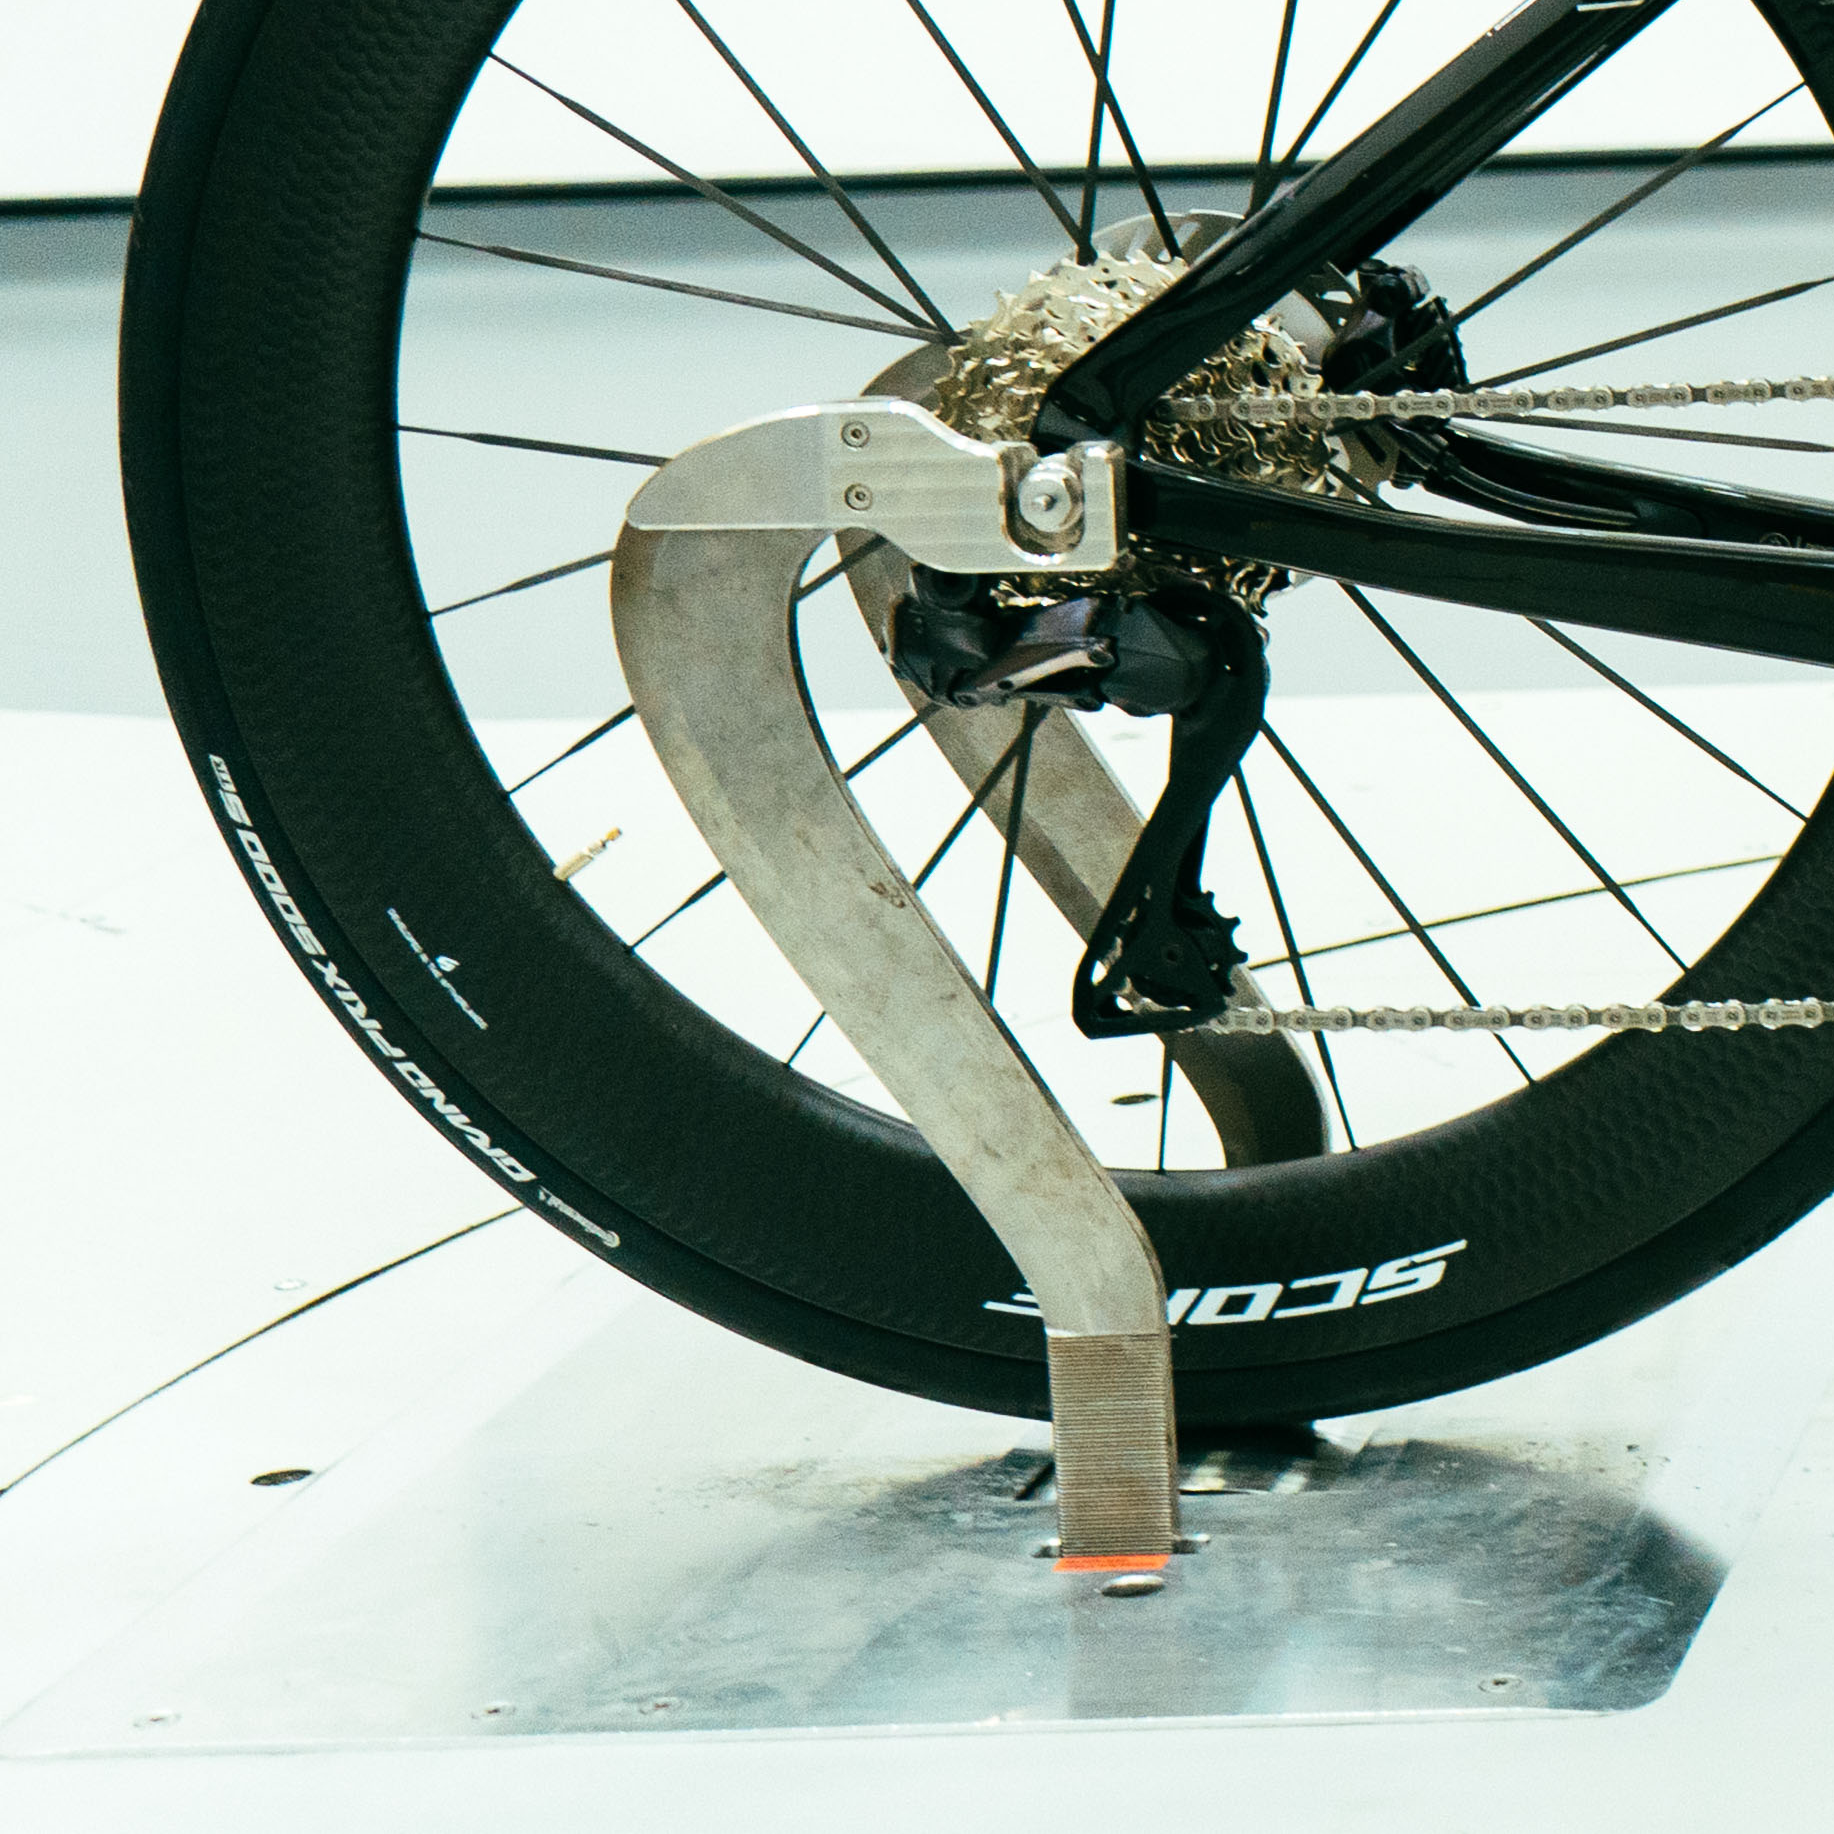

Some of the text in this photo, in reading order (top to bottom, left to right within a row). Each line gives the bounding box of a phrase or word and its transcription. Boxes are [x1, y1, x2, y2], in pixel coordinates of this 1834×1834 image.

[219, 790, 254, 827] S
[236, 828, 327, 956] 5000
[312, 959, 407, 1058] PRIX
[394, 1061, 537, 1182] GRAND
[983, 1239, 1467, 1326] SCO
